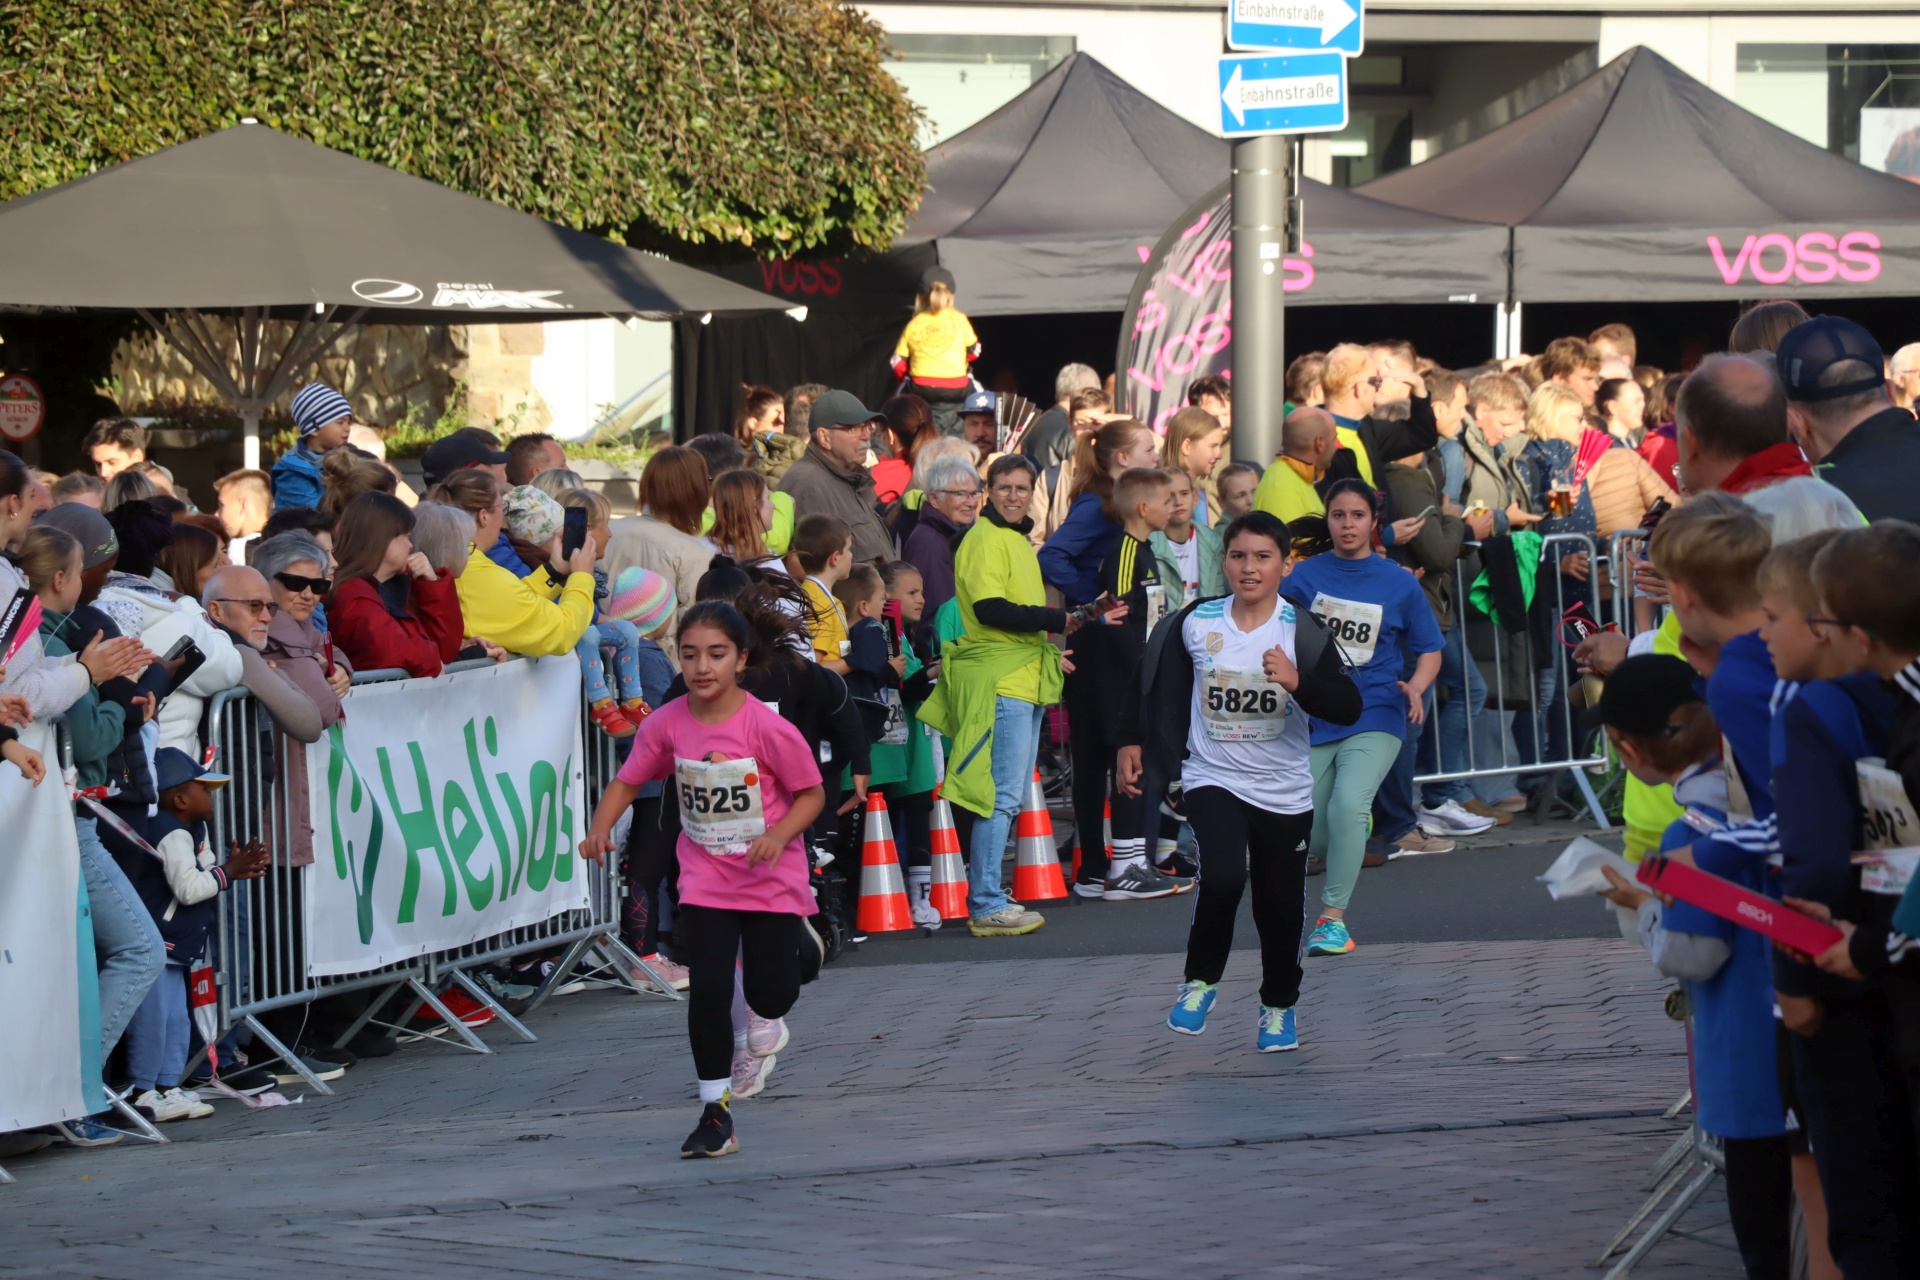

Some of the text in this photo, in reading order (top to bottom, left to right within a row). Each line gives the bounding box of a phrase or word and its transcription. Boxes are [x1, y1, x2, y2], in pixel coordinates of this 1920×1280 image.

[1238, 2, 1324, 21] Einbahnstraße
[1240, 82, 1334, 103] Einbahnstraße
[1706, 231, 1882, 285] VOSS
[436, 282, 493, 290] pepsi
[760, 256, 843, 295] VOSS
[432, 290, 566, 309] MAX
[1127, 298, 1231, 391] VOS
[0, 402, 38, 414] PETERS
[0, 596, 25, 638] CHANCEN.
[1316, 612, 1371, 643] 968
[890, 703, 905, 722] 26
[1208, 686, 1277, 714] 5826
[681, 782, 750, 813] 5525
[376, 716, 573, 924] Helios
